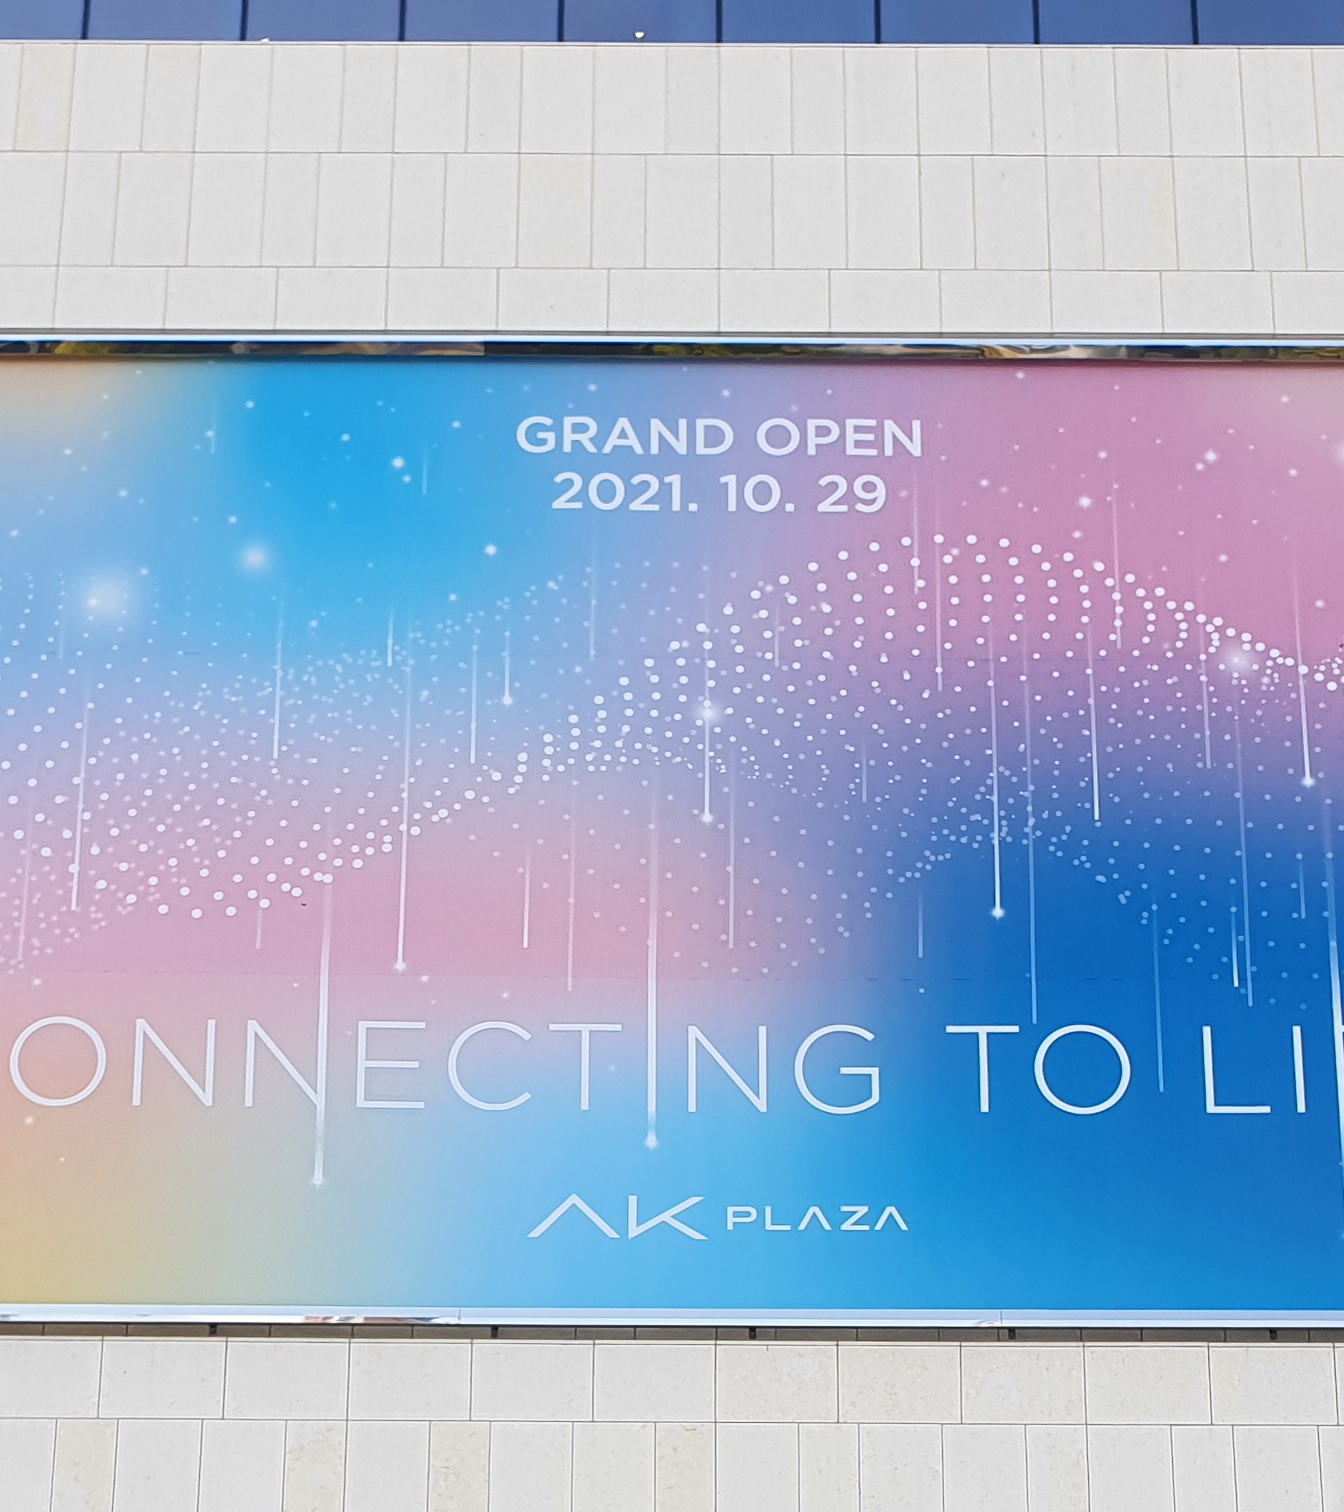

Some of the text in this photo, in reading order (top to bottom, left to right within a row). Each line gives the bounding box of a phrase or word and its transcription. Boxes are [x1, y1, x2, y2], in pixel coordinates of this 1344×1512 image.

[515, 415, 923, 457] GRAND OPEN
[550, 471, 887, 513] 2021. 10. 29
[945, 1023, 1132, 1116] TO
[525, 1193, 909, 1241] AK PLAZA
